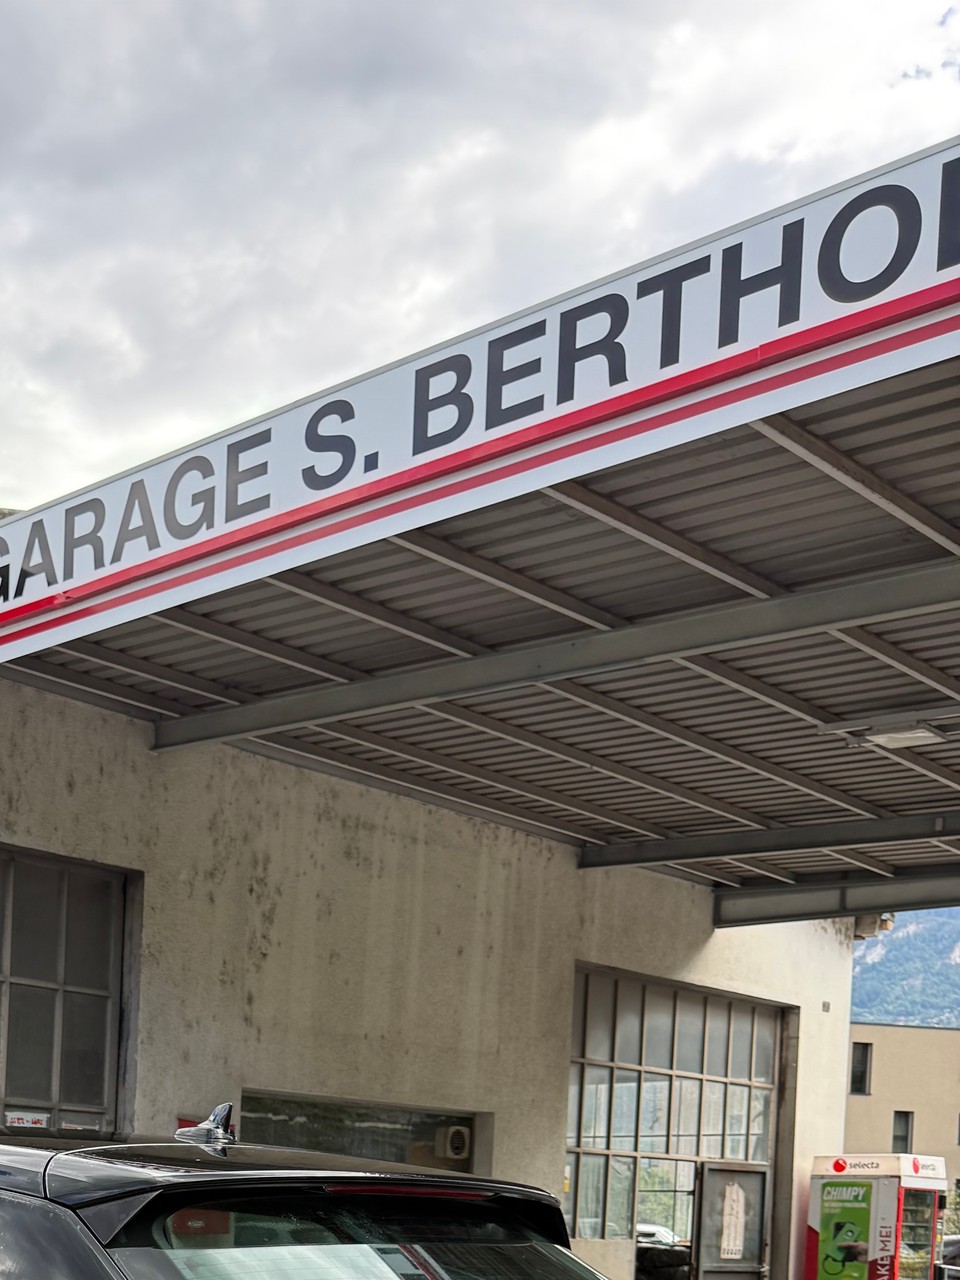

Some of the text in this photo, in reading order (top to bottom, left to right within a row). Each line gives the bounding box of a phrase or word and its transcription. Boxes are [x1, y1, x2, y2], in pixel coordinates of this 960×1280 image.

[301, 399, 379, 491] S.
[848, 1161, 880, 1169] selecta
[823, 1187, 866, 1200] CHIMPY
[879, 1225, 892, 1251] ME!
